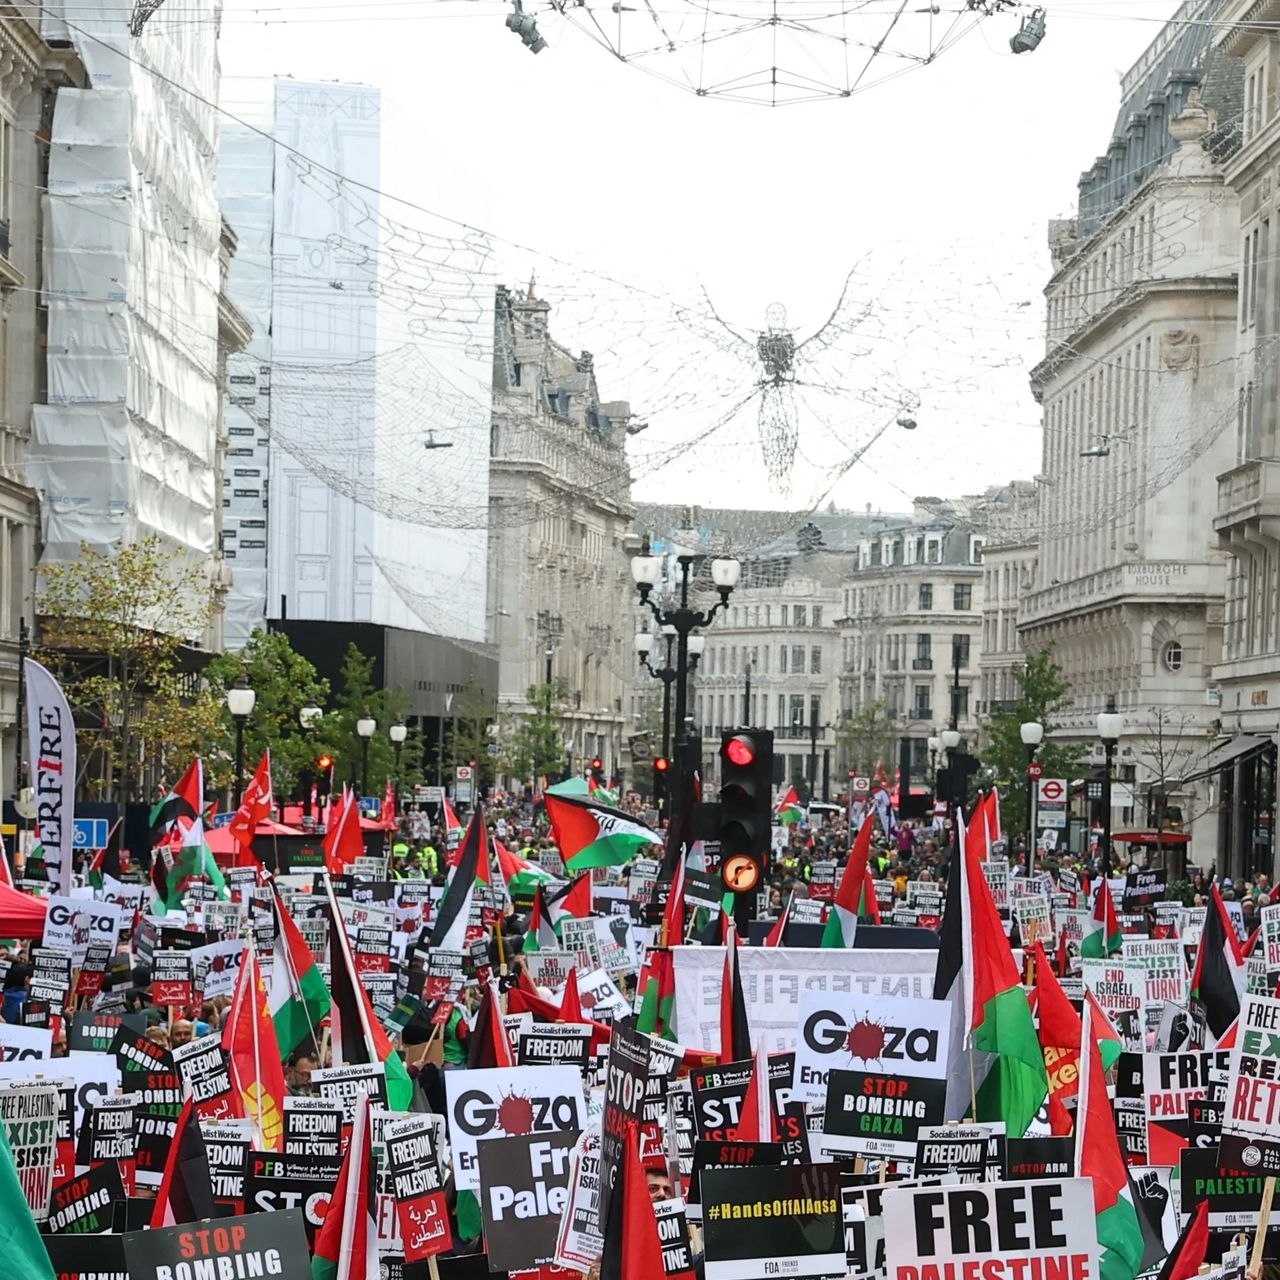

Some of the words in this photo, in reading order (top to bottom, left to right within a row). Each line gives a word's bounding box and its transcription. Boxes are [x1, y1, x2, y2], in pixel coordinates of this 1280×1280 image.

[1135, 874, 1157, 883] Free
[1126, 882, 1165, 897] Palestine
[155, 956, 189, 970] FREEDOM
[154, 972, 190, 984] PALESTINE
[803, 1010, 938, 1062] Gza
[863, 1077, 908, 1097] STOP
[842, 1094, 926, 1119] BOMBING
[859, 1114, 904, 1135] GAZA
[708, 1197, 838, 1221] #HandsOffAlAqsa
[916, 1184, 1067, 1257] FREE
